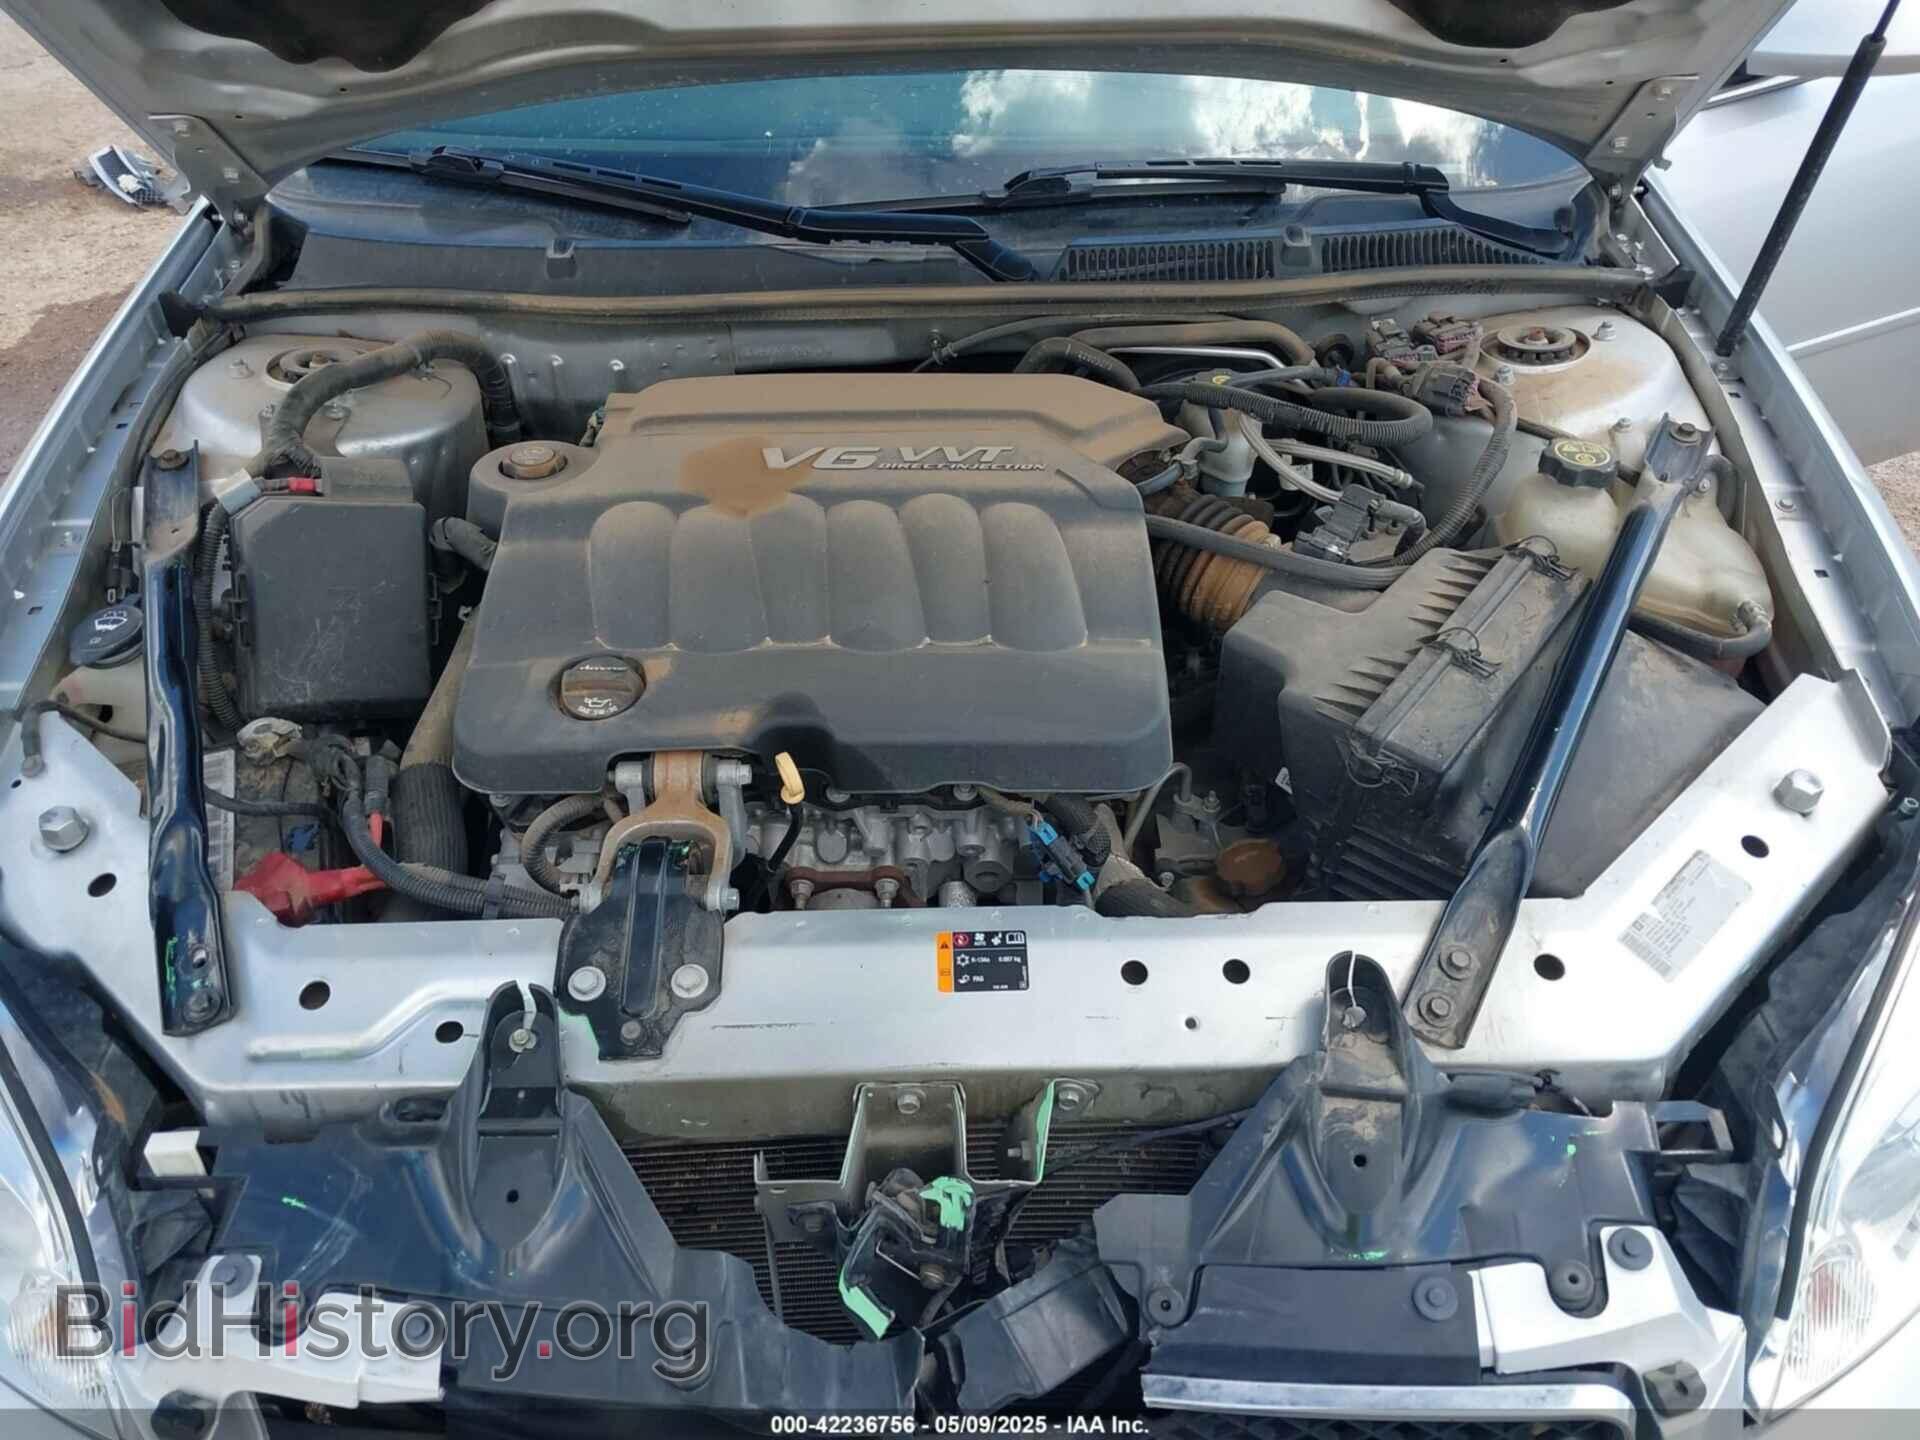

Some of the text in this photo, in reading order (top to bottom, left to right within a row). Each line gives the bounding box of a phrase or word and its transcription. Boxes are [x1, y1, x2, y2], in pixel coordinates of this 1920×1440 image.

[762, 446, 1014, 470] V6 VVT
[948, 463, 1046, 471] INJECTION
